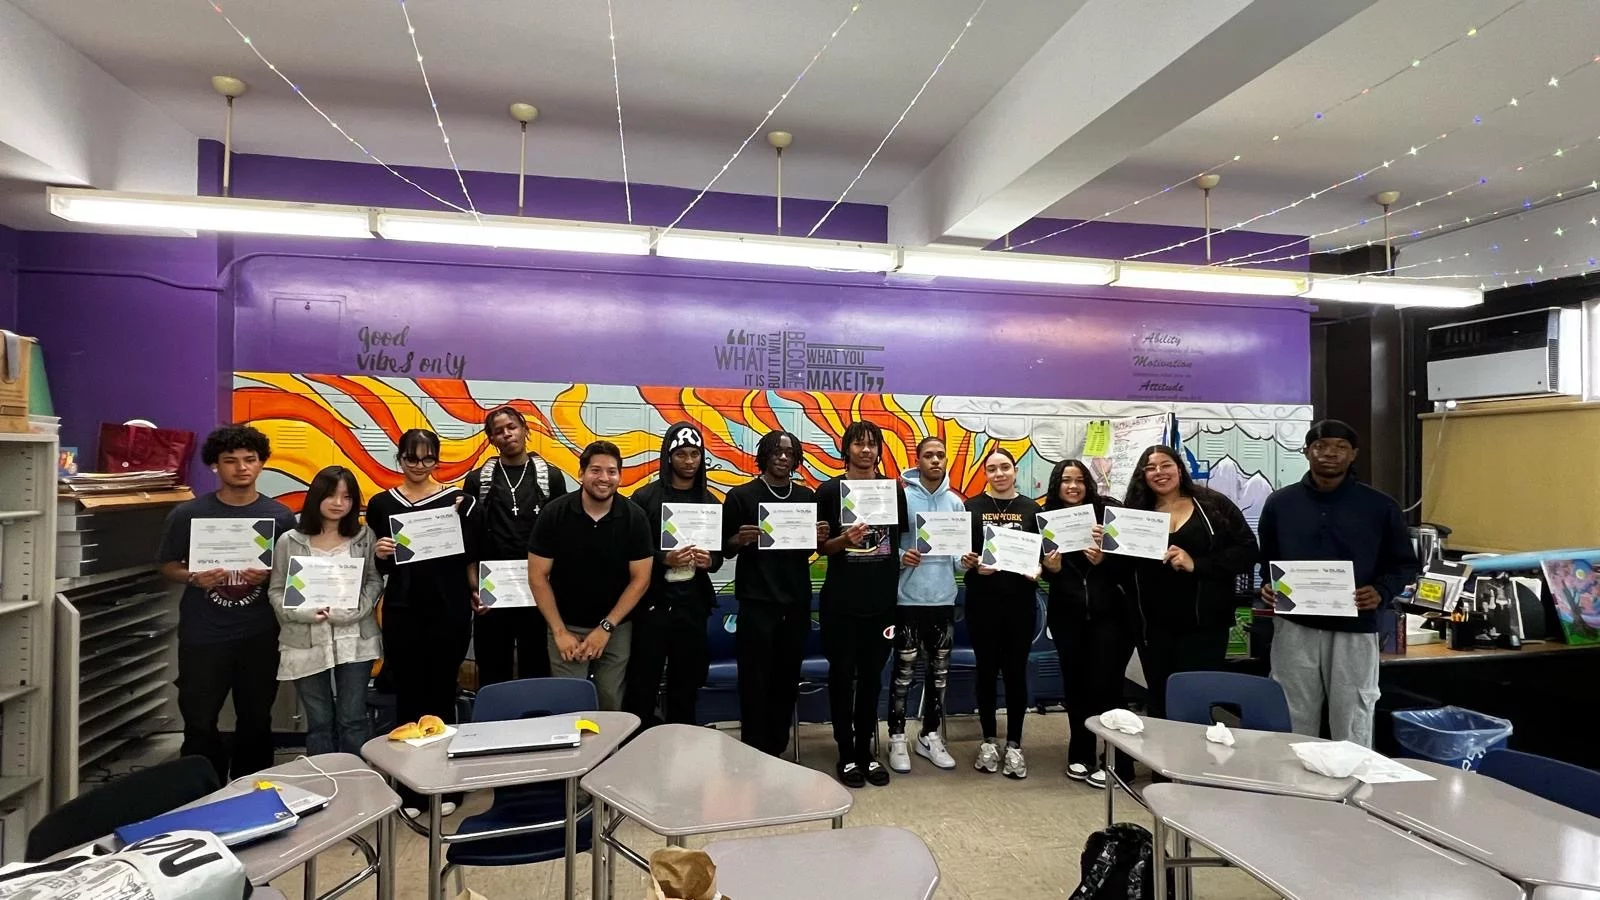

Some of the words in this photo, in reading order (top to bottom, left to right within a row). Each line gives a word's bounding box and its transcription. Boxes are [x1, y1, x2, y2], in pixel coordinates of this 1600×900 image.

[359, 325, 410, 354] good
[757, 335, 767, 346] IS
[768, 331, 781, 355] WILL
[1143, 332, 1181, 346] Ability
[714, 345, 766, 371] WHAT
[768, 357, 781, 368] IT
[787, 331, 805, 390] BECOME
[807, 349, 839, 364] WHAT
[842, 350, 864, 365] YOU
[1133, 355, 1192, 368] Motivation
[420, 352, 466, 378] only
[744, 374, 753, 386] IT
[756, 375, 765, 387] IS
[768, 370, 781, 388] BUT
[1138, 380, 1184, 391] Attitude
[1002, 513, 1022, 521] YORK
